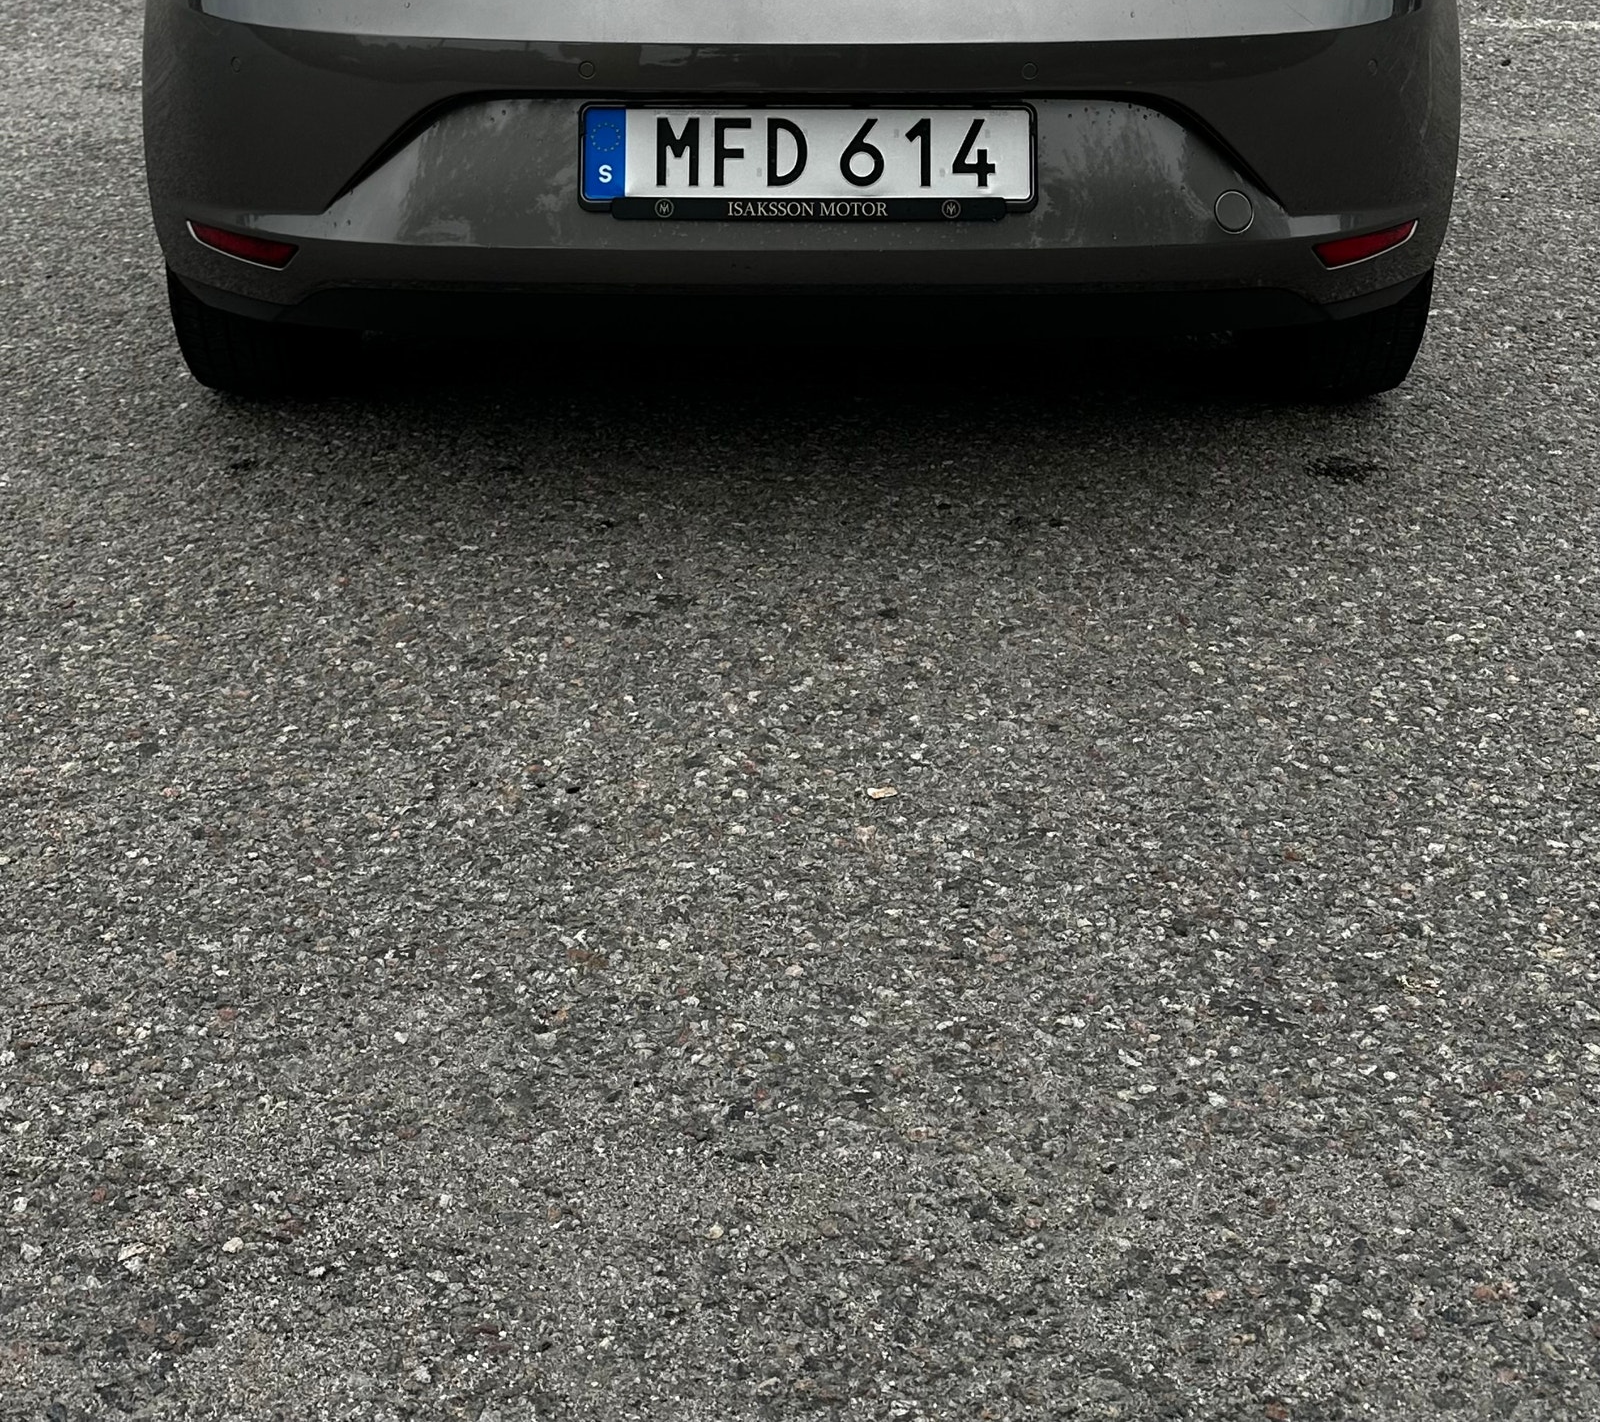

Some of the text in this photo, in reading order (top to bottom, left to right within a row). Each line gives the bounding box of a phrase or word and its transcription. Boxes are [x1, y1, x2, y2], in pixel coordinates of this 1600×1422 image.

[656, 117, 996, 188] MFD 614
[598, 164, 613, 183] S
[727, 201, 889, 217] ISAKSSON MOTOR
